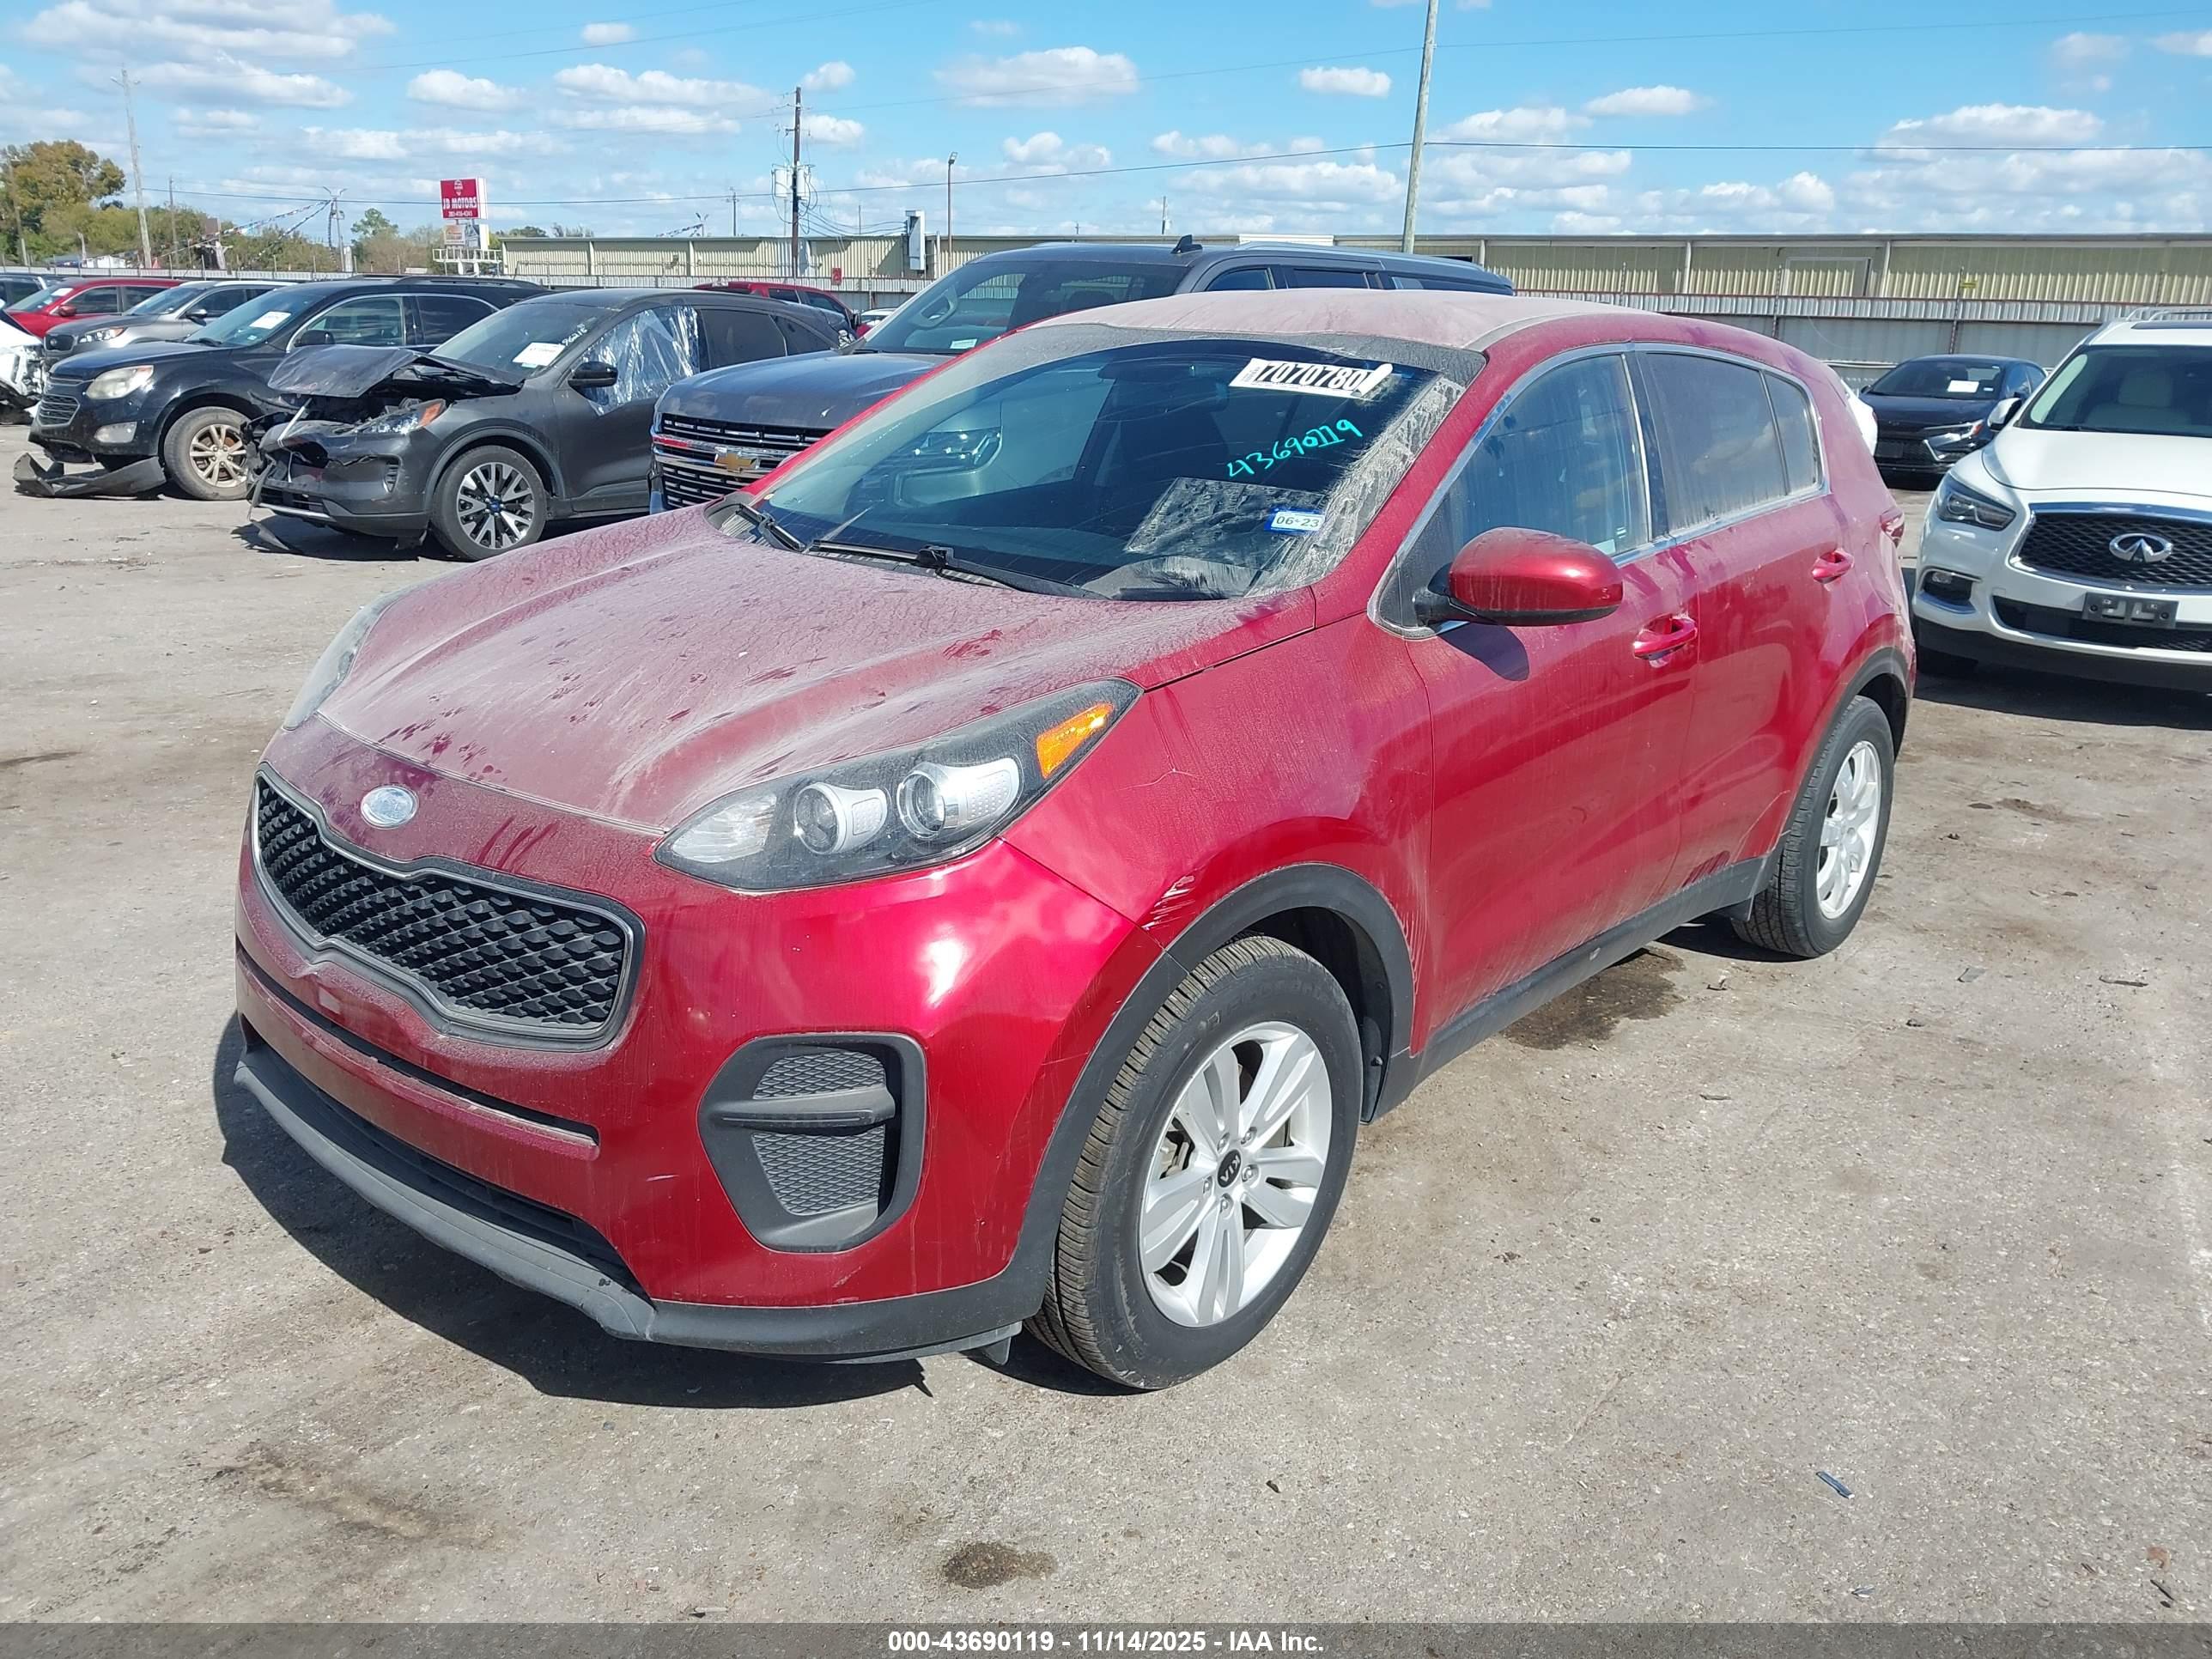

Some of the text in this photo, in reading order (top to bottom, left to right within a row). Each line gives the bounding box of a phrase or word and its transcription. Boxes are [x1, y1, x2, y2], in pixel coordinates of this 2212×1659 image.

[451, 197, 477, 209] MOTORS
[1256, 362, 1367, 391] 7070780
[1226, 419, 1364, 477] 43690119
[1219, 1154, 1241, 1182] KIA
